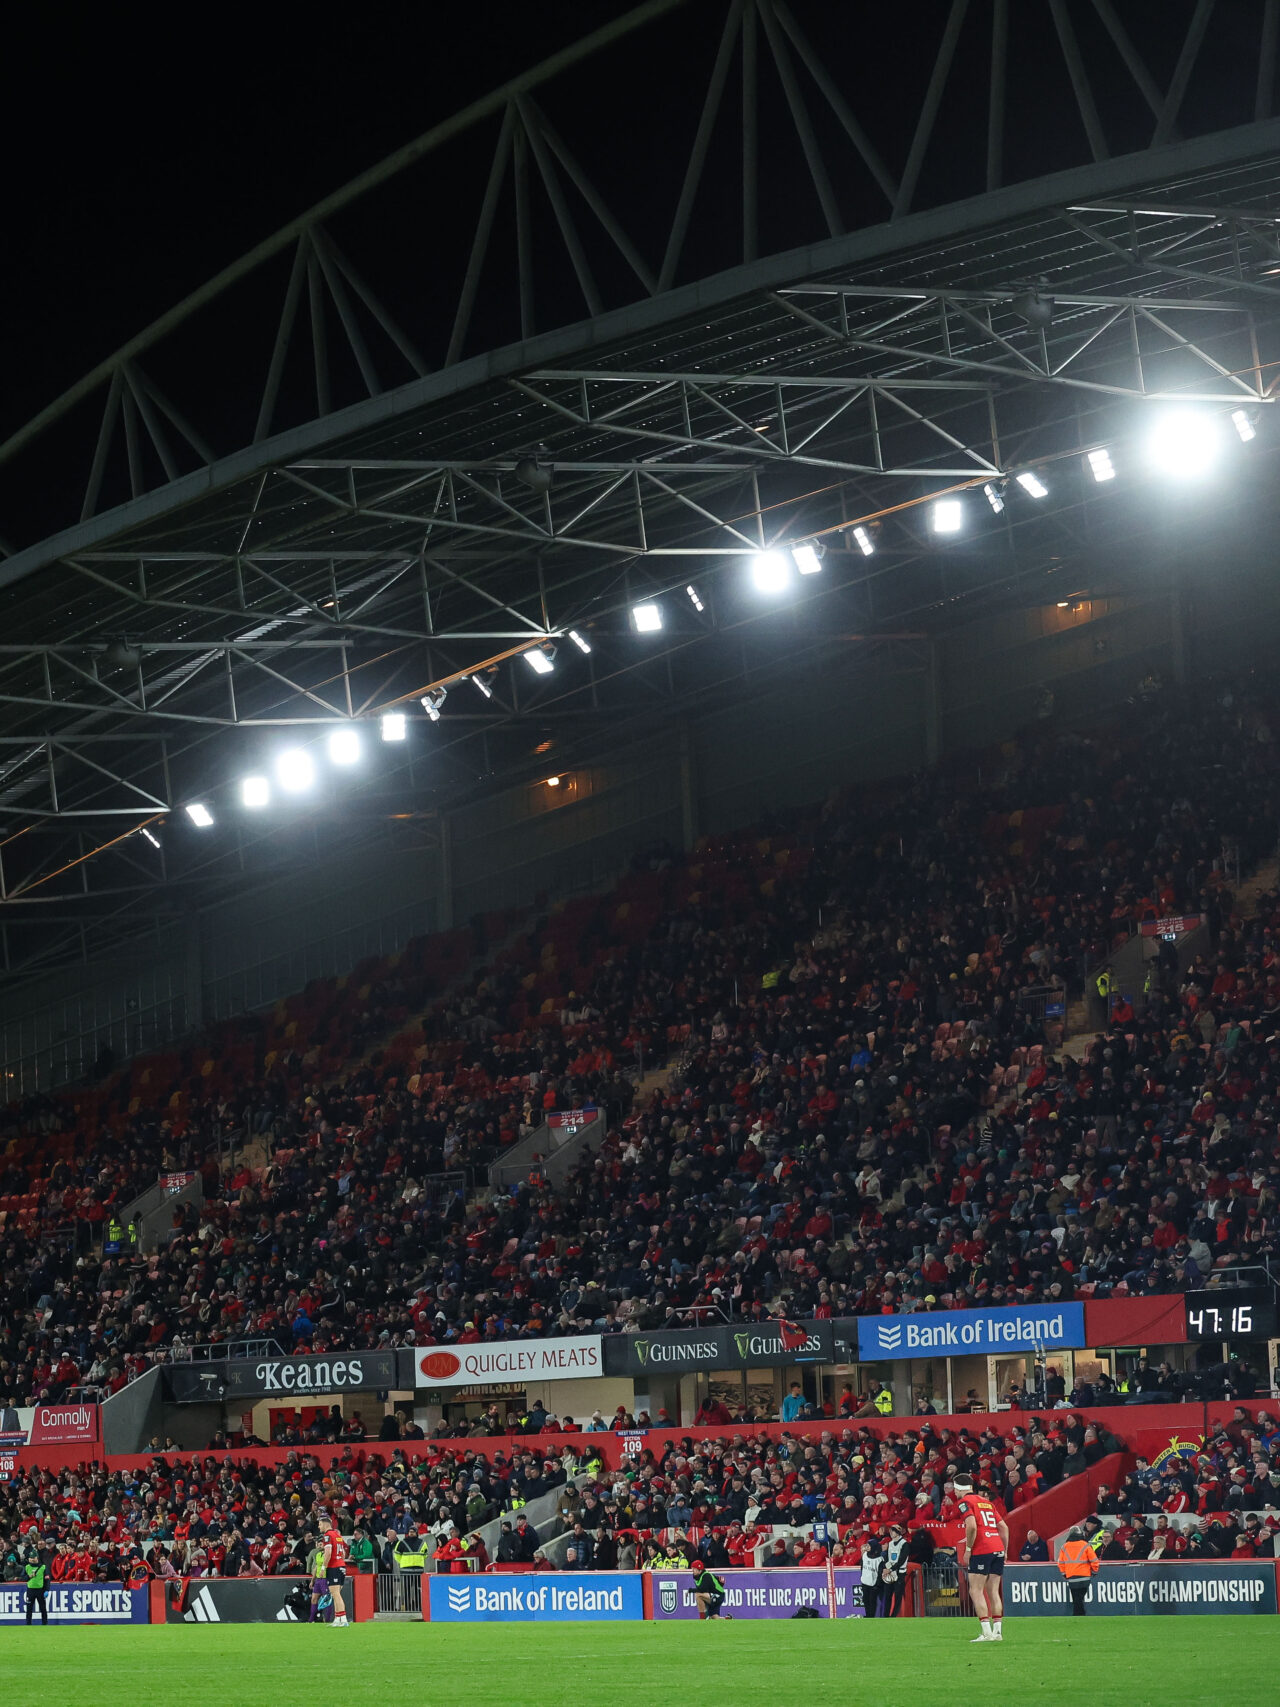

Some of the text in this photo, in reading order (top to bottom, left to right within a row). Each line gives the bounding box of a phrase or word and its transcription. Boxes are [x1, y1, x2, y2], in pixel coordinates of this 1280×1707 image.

[1156, 924, 1184, 935] 215
[560, 1117, 584, 1126] 214
[167, 1179, 186, 1187] 213
[907, 1314, 1063, 1347] Bank of Ireland
[1189, 1306, 1252, 1334] 47:16
[465, 1347, 597, 1376] QUIGLEY MEATS
[650, 1342, 718, 1362] GUINNESS
[256, 1360, 363, 1390] Keanes
[41, 1407, 91, 1429] Connolly
[623, 1441, 642, 1452] 109
[0, 1460, 14, 1470] 108
[980, 1510, 998, 1528] 15
[72, 1589, 132, 1612] SPORTS
[475, 1586, 623, 1611] Bank of Ireland
[745, 1588, 766, 1607] THE
[769, 1588, 793, 1606] URC
[795, 1588, 816, 1606] APP
[819, 1587, 846, 1606] NW
[1011, 1582, 1038, 1603] BKT
[1097, 1581, 1145, 1603] RUGBY
[1148, 1579, 1265, 1602] CHAMPIONSHIP
